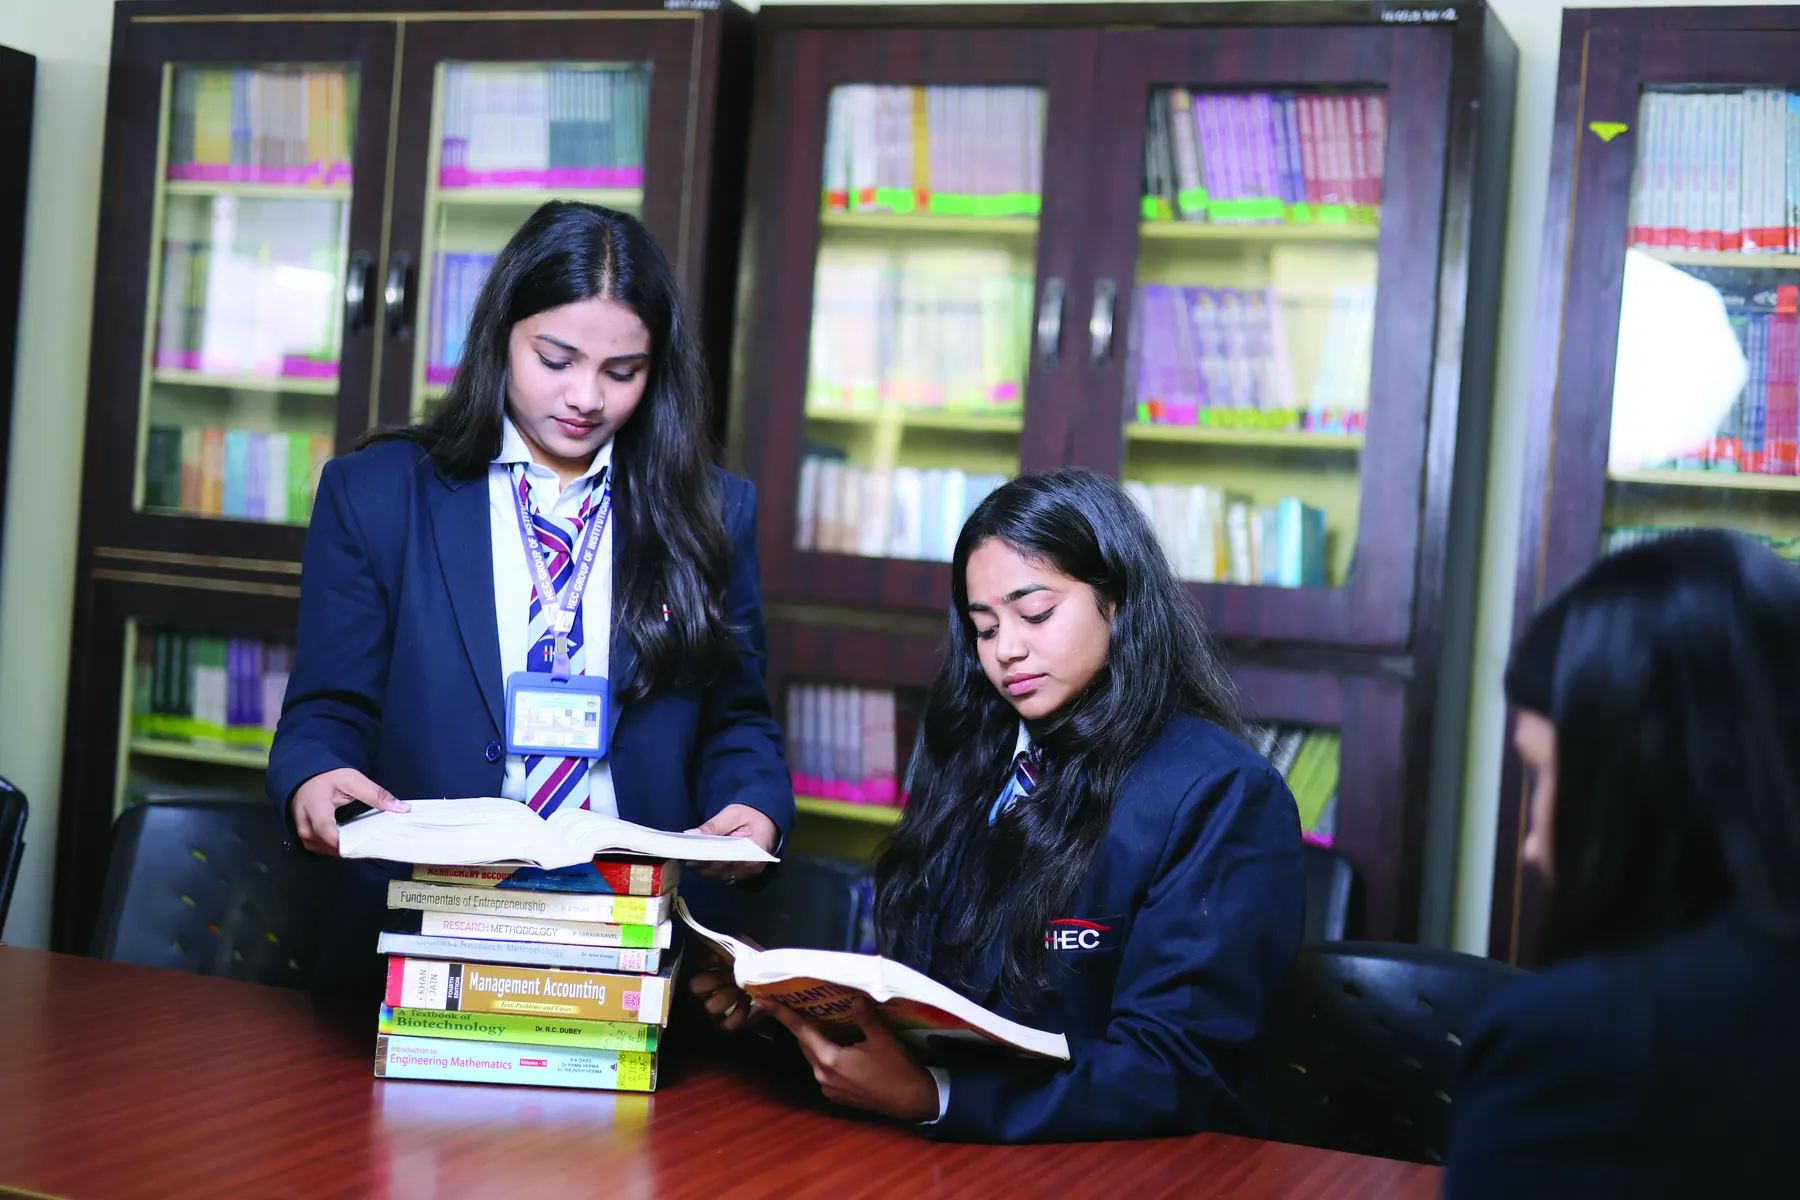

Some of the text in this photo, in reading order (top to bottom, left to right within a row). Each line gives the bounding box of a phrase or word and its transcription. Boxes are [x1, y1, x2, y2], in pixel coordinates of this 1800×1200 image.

[588, 495, 611, 550] INSTITUTIONS
[528, 537, 539, 549] OF
[531, 549, 548, 580] GROUP
[584, 549, 594, 562] OF
[574, 562, 590, 590] GROUP
[541, 580, 555, 601] HEC
[566, 590, 580, 610] HEC
[427, 867, 480, 879] MANAGEMENT
[400, 890, 461, 907] Fundamentals
[462, 895, 473, 908] of
[473, 895, 546, 913] Entrepreneurship
[443, 920, 559, 937] RESEARCH METHODOLOGY
[460, 941, 503, 952] Research
[506, 943, 565, 958] Methodology
[418, 969, 427, 995] KHAN
[428, 973, 438, 996] JAIN
[447, 976, 455, 998] FOURTH
[453, 976, 461, 999] EDITION
[469, 971, 607, 1005] Management Accounting
[411, 1010, 458, 1020] Textbook
[460, 1013, 473, 1021] of
[515, 1002, 542, 1011] Problems
[397, 1016, 507, 1036] Biotechnology
[559, 1027, 582, 1035] DUBEY
[391, 1045, 429, 1055] Introduction
[390, 1053, 512, 1070] Engineering Mathematics
